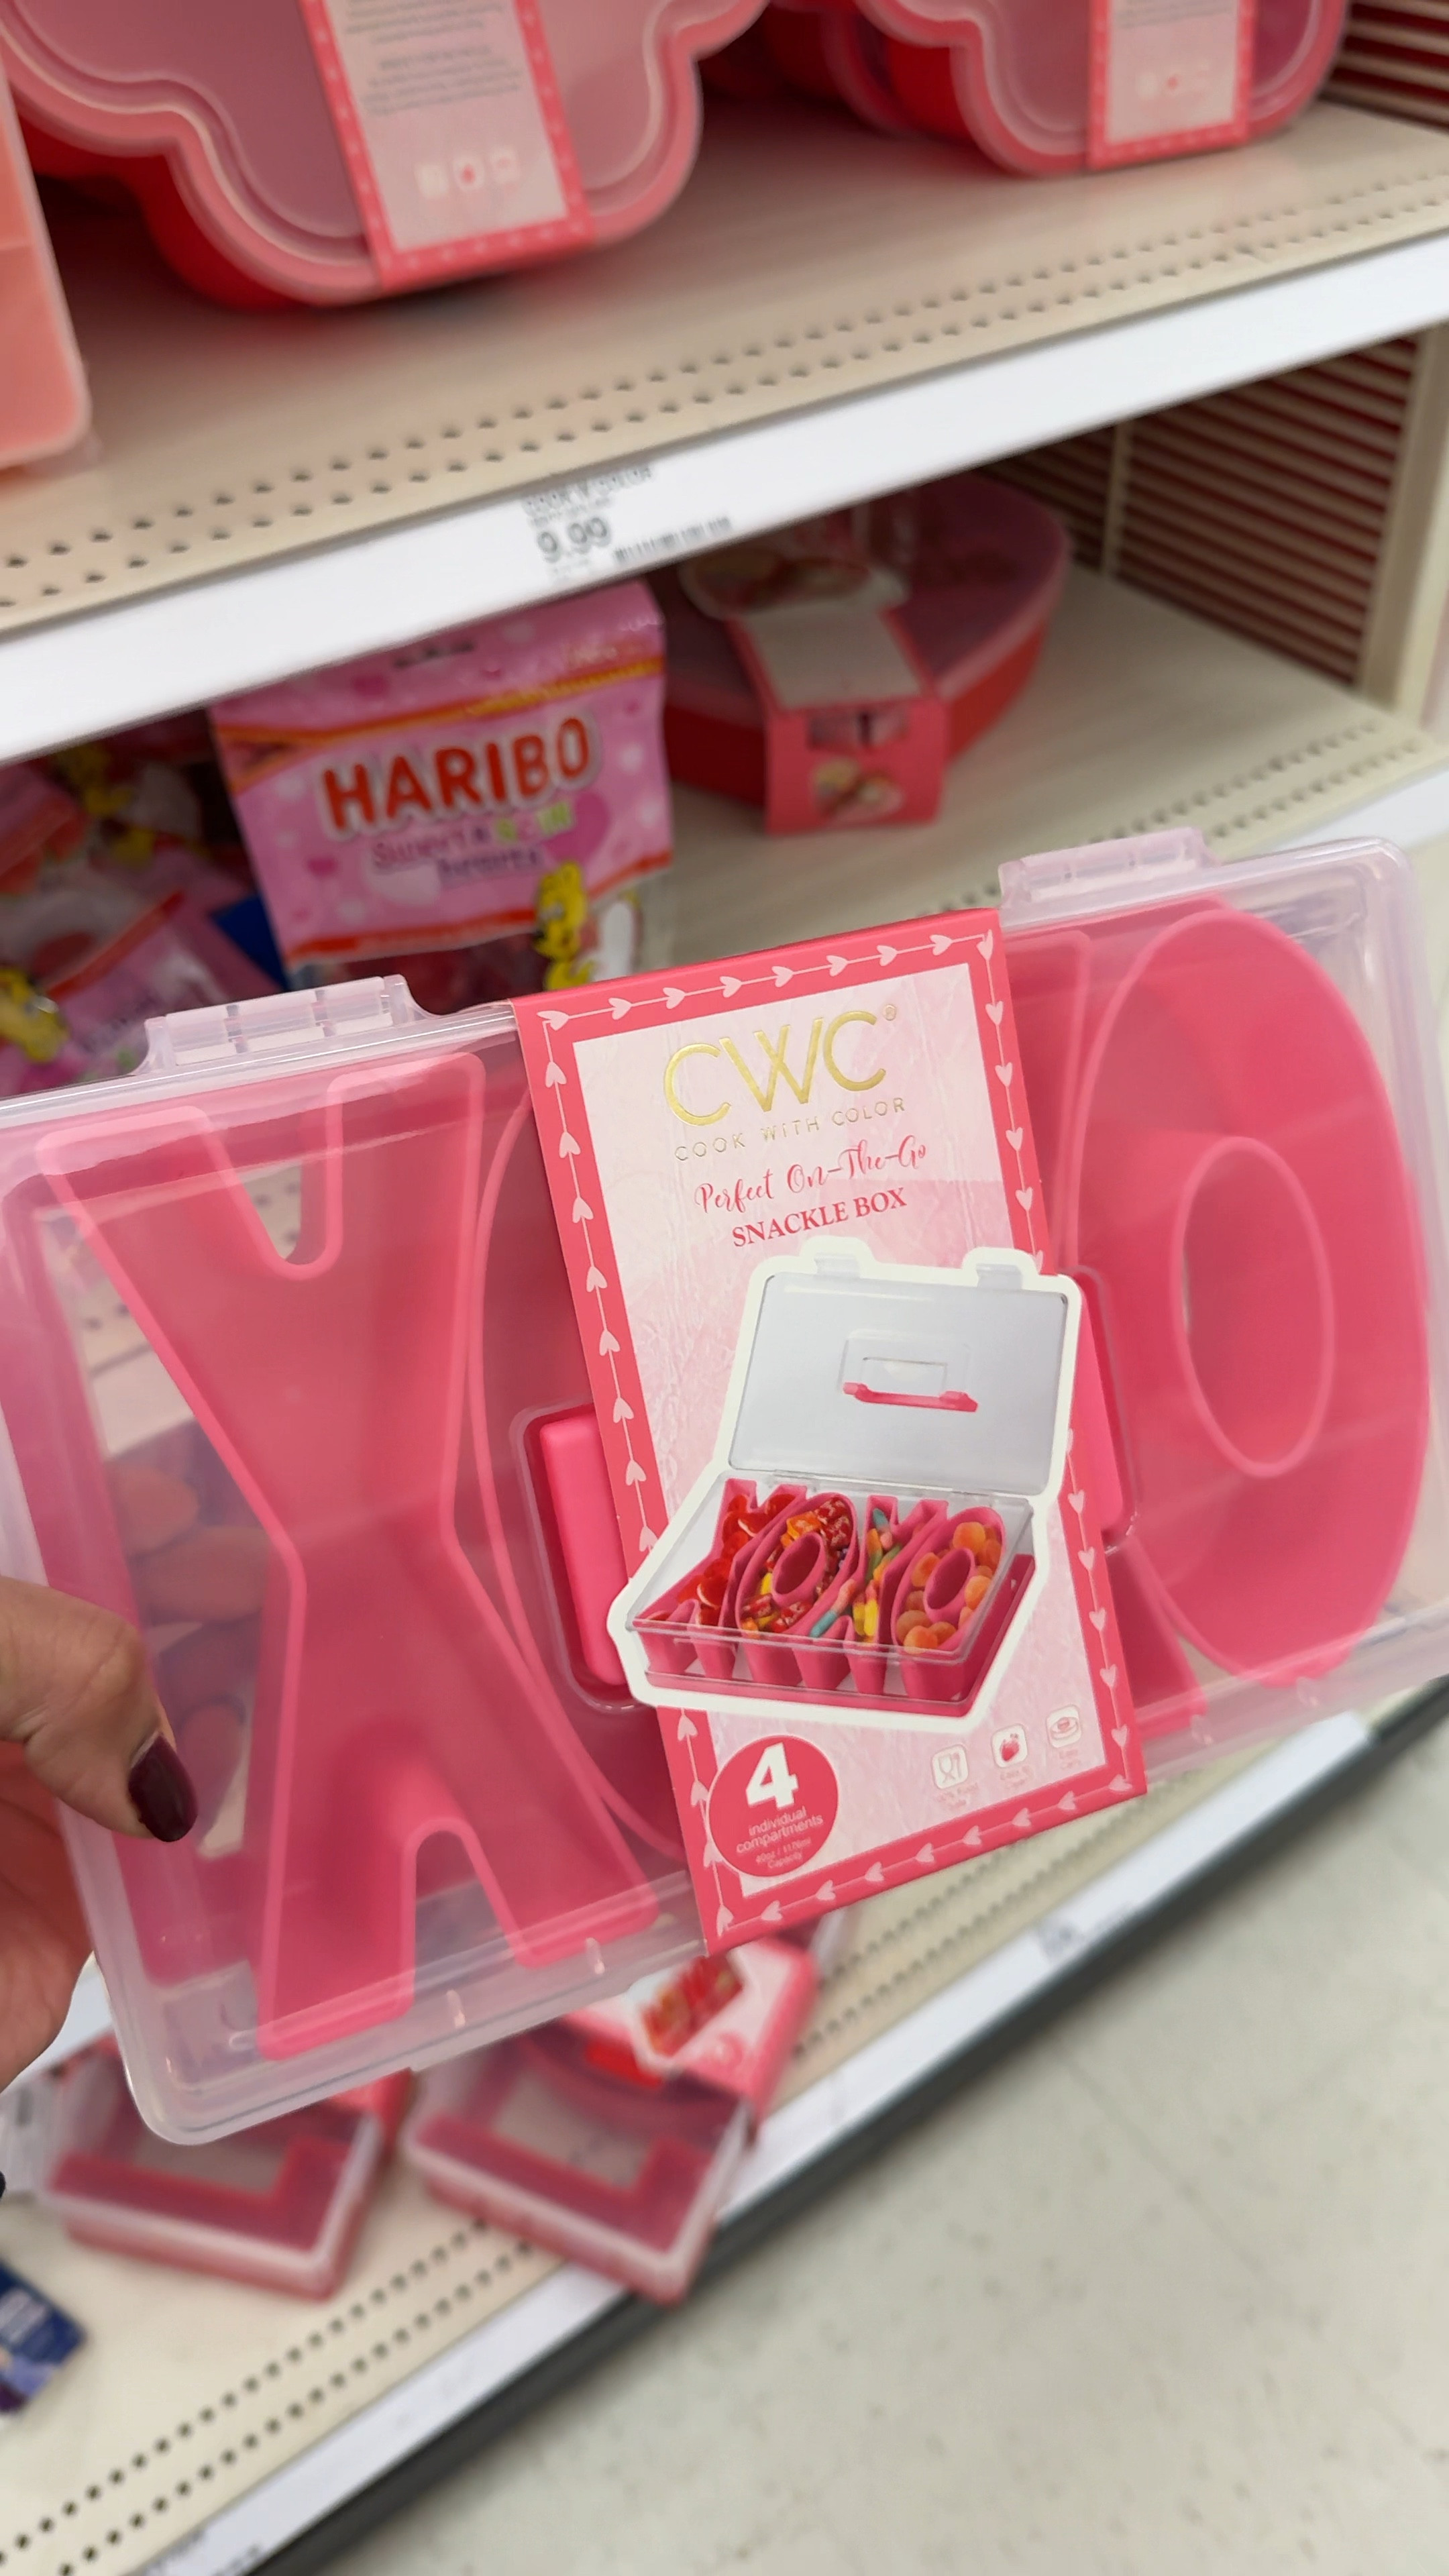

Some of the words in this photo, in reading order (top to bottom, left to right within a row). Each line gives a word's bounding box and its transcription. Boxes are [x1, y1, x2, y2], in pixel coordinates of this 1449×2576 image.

[537, 517, 612, 564] 9.99
[318, 715, 594, 835] HARIBO
[675, 1132, 745, 1162] COOK
[760, 1116, 820, 1141] WITH
[831, 1097, 906, 1126] COLOR
[694, 1168, 775, 1214] Perfect
[786, 1134, 926, 1193] On-The-Go
[731, 1200, 849, 1248] SNACKLE
[853, 1187, 908, 1218] BOX
[745, 1741, 800, 1810] 4
[736, 1814, 824, 1854] compartments
[748, 1805, 808, 1837] individual
